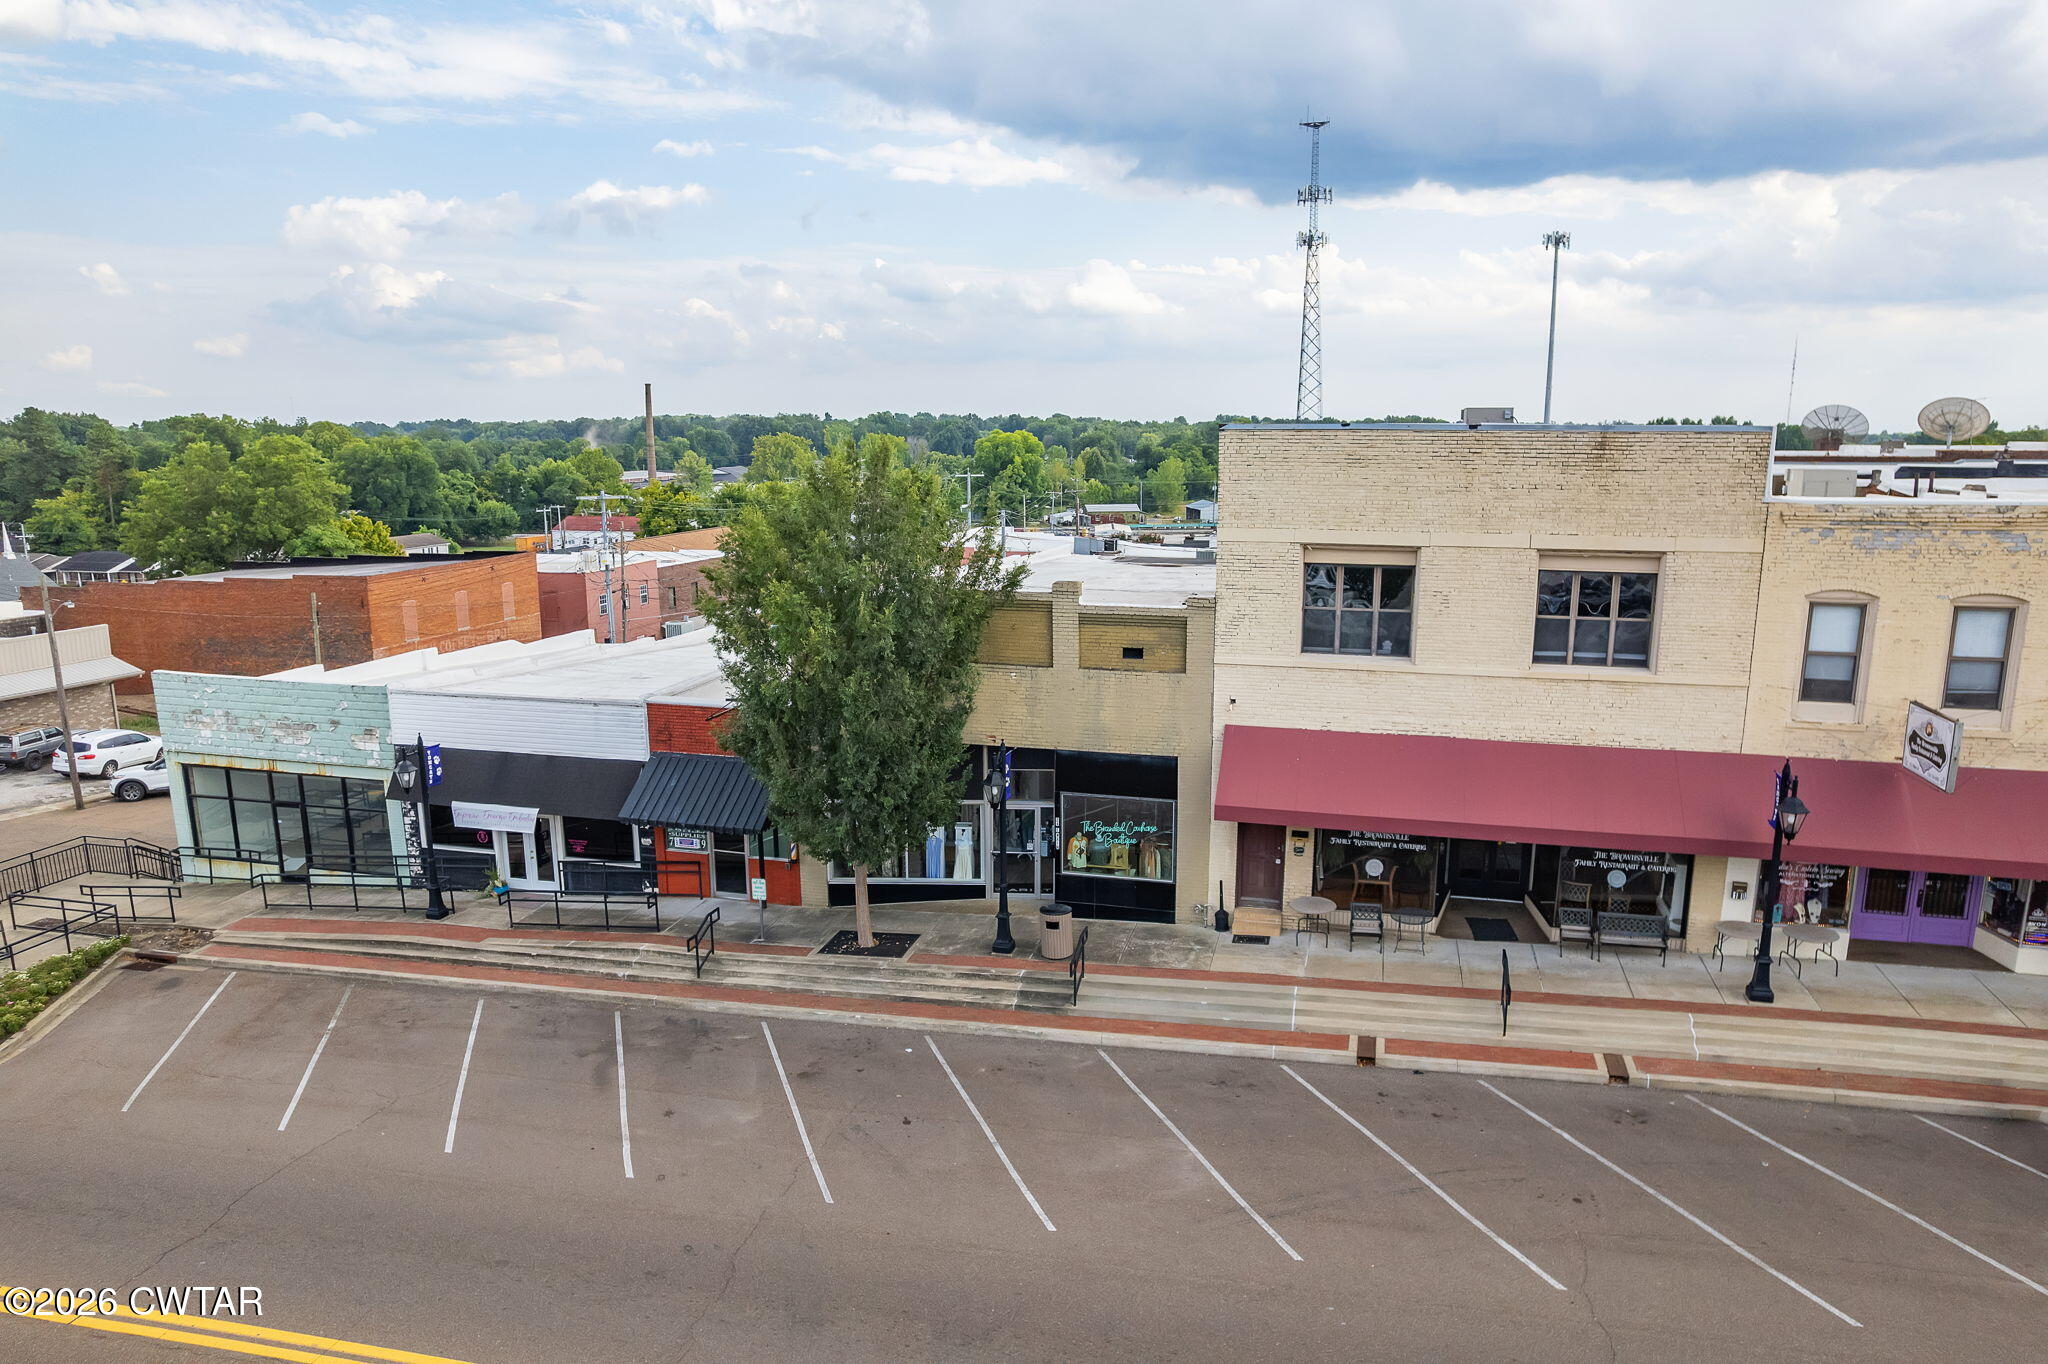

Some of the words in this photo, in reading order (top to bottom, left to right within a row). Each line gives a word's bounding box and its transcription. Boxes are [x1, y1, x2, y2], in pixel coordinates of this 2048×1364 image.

[1080, 820, 1094, 834] The
[1094, 821, 1126, 838] Branded
[1102, 833, 1137, 848] Boutique
[1593, 851, 1608, 859] THE
[1610, 852, 1659, 862] BROWNSVILLE
[1574, 859, 1598, 868] FAMILY
[1599, 860, 1640, 871] RESTAURANT
